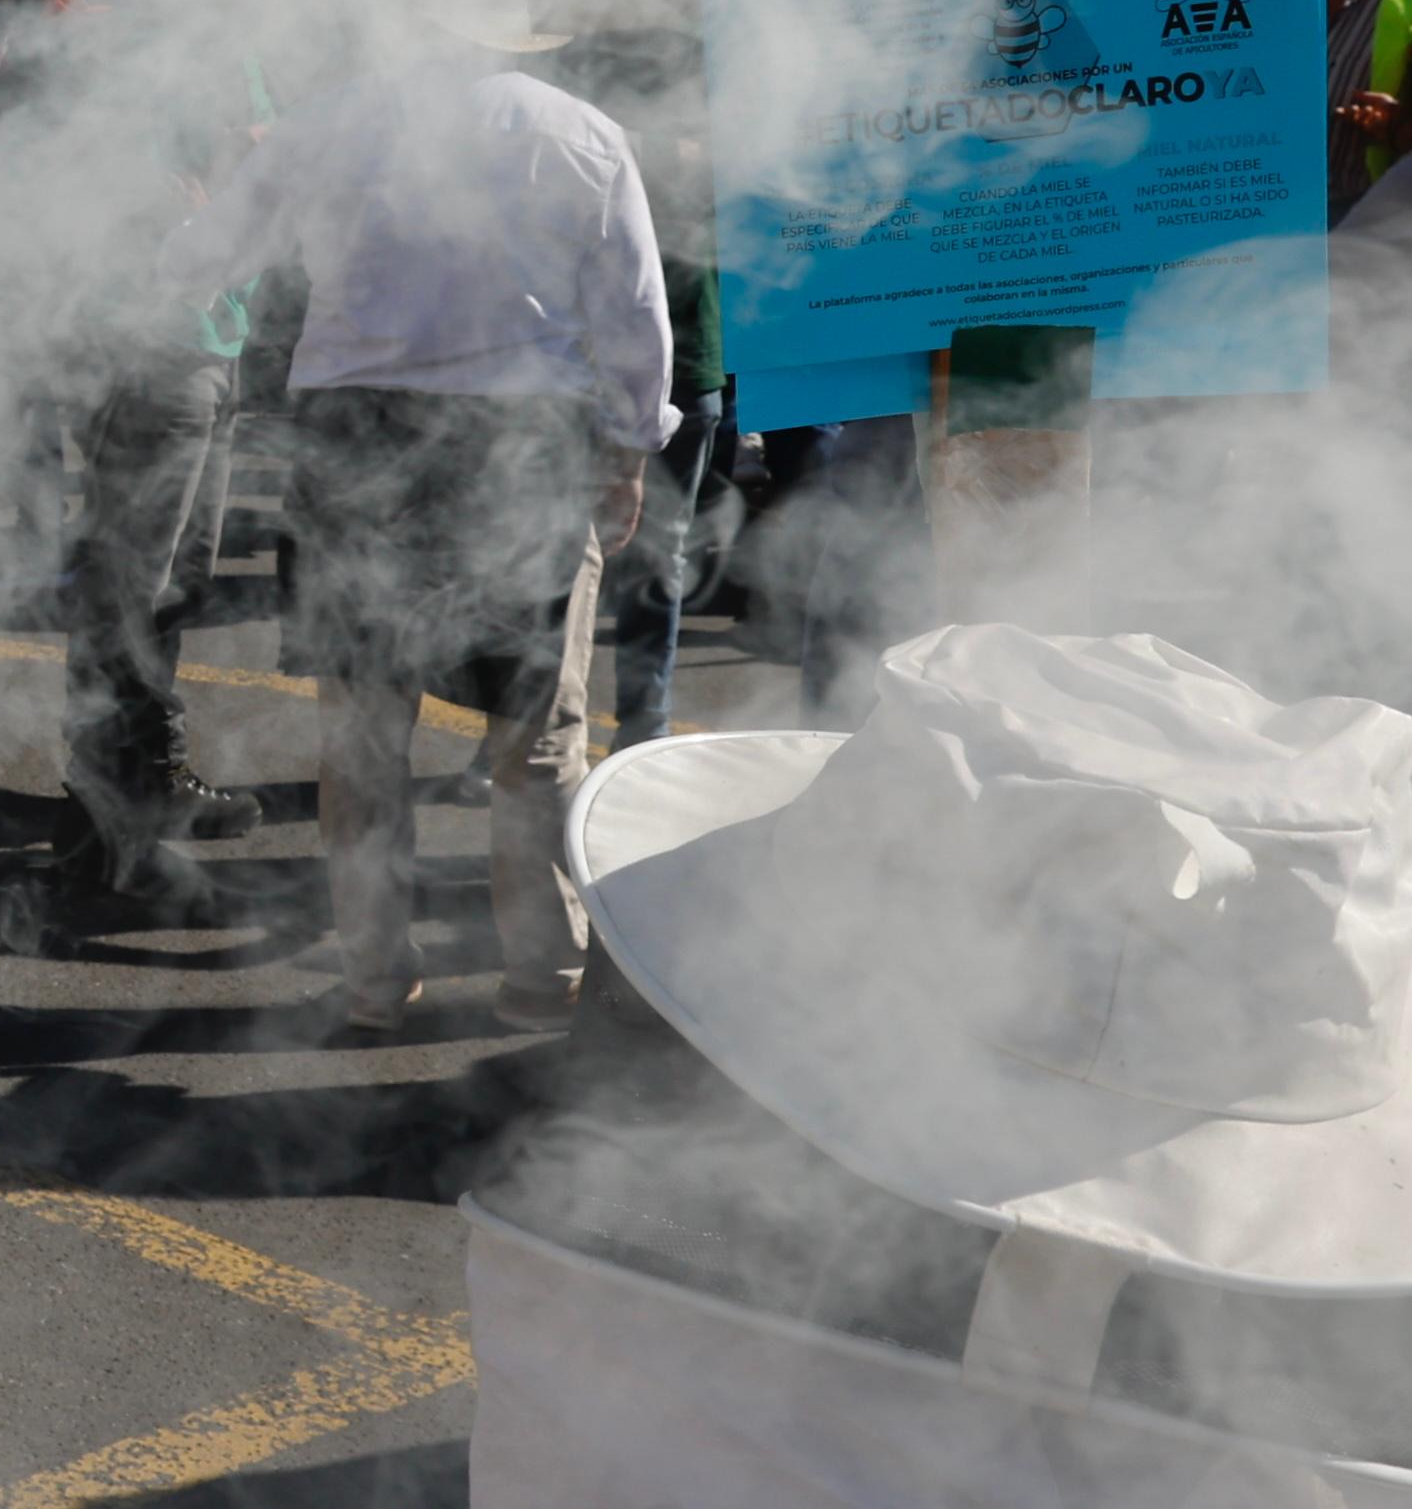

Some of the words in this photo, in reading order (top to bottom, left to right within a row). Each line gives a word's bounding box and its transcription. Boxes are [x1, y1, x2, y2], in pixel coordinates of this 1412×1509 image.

[980, 68, 1078, 89] ASOCIACIONES
[1082, 65, 1110, 79] POR
[1113, 62, 1133, 74] UN
[1138, 141, 1182, 157] MIEL
[1187, 131, 1283, 153] NATURAL
[1157, 160, 1219, 179] TAMBIÉN
[1222, 157, 1262, 173] DEBE
[959, 186, 1017, 203] CUANDO
[1021, 184, 1039, 196] LA
[1041, 180, 1071, 193] MIEL
[1074, 176, 1092, 190] SE
[1136, 179, 1211, 198] INFORMAR
[1214, 177, 1227, 190] SI
[1230, 175, 1247, 189] ES
[1250, 172, 1284, 186] MIEL
[1004, 202, 1022, 215] EN
[1024, 199, 1042, 212] LA
[1044, 190, 1109, 210] ETIQUETA
[1133, 196, 1196, 214] NATURAL
[1199, 194, 1212, 207] O
[1215, 194, 1228, 207] SI
[1230, 191, 1250, 204] HA
[1254, 188, 1290, 202] SIDO
[890, 212, 921, 227] QUE
[931, 222, 969, 238] DEBE
[972, 216, 1032, 233] FIGURAR
[1034, 213, 1050, 227] EL
[1066, 209, 1084, 223] DE
[1087, 205, 1120, 219] MIEL
[1157, 206, 1265, 227] PASTEURIZADA.
[818, 235, 857, 250] VIENE
[860, 236, 876, 246] LA
[929, 240, 960, 254] QUE
[962, 236, 978, 250] SE
[982, 232, 1037, 248] MEZCLA
[1039, 230, 1049, 242] Y
[1051, 227, 1068, 241] EL
[1069, 221, 1121, 239] ORIGEN
[977, 251, 997, 264] DE
[999, 246, 1039, 262] CADA
[808, 299, 822, 310] La
[823, 293, 882, 311] plataforma
[883, 287, 936, 303] agradece
[936, 287, 944, 295] a
[945, 283, 976, 294] todas
[977, 280, 993, 291] las
[1070, 262, 1151, 282] organizaciones
[1153, 263, 1161, 273] y
[1162, 255, 1228, 272] particulares
[963, 288, 1017, 305] colaboran
[1020, 289, 1035, 299] en
[1036, 287, 1048, 298] la
[1049, 284, 1090, 297] misma.
